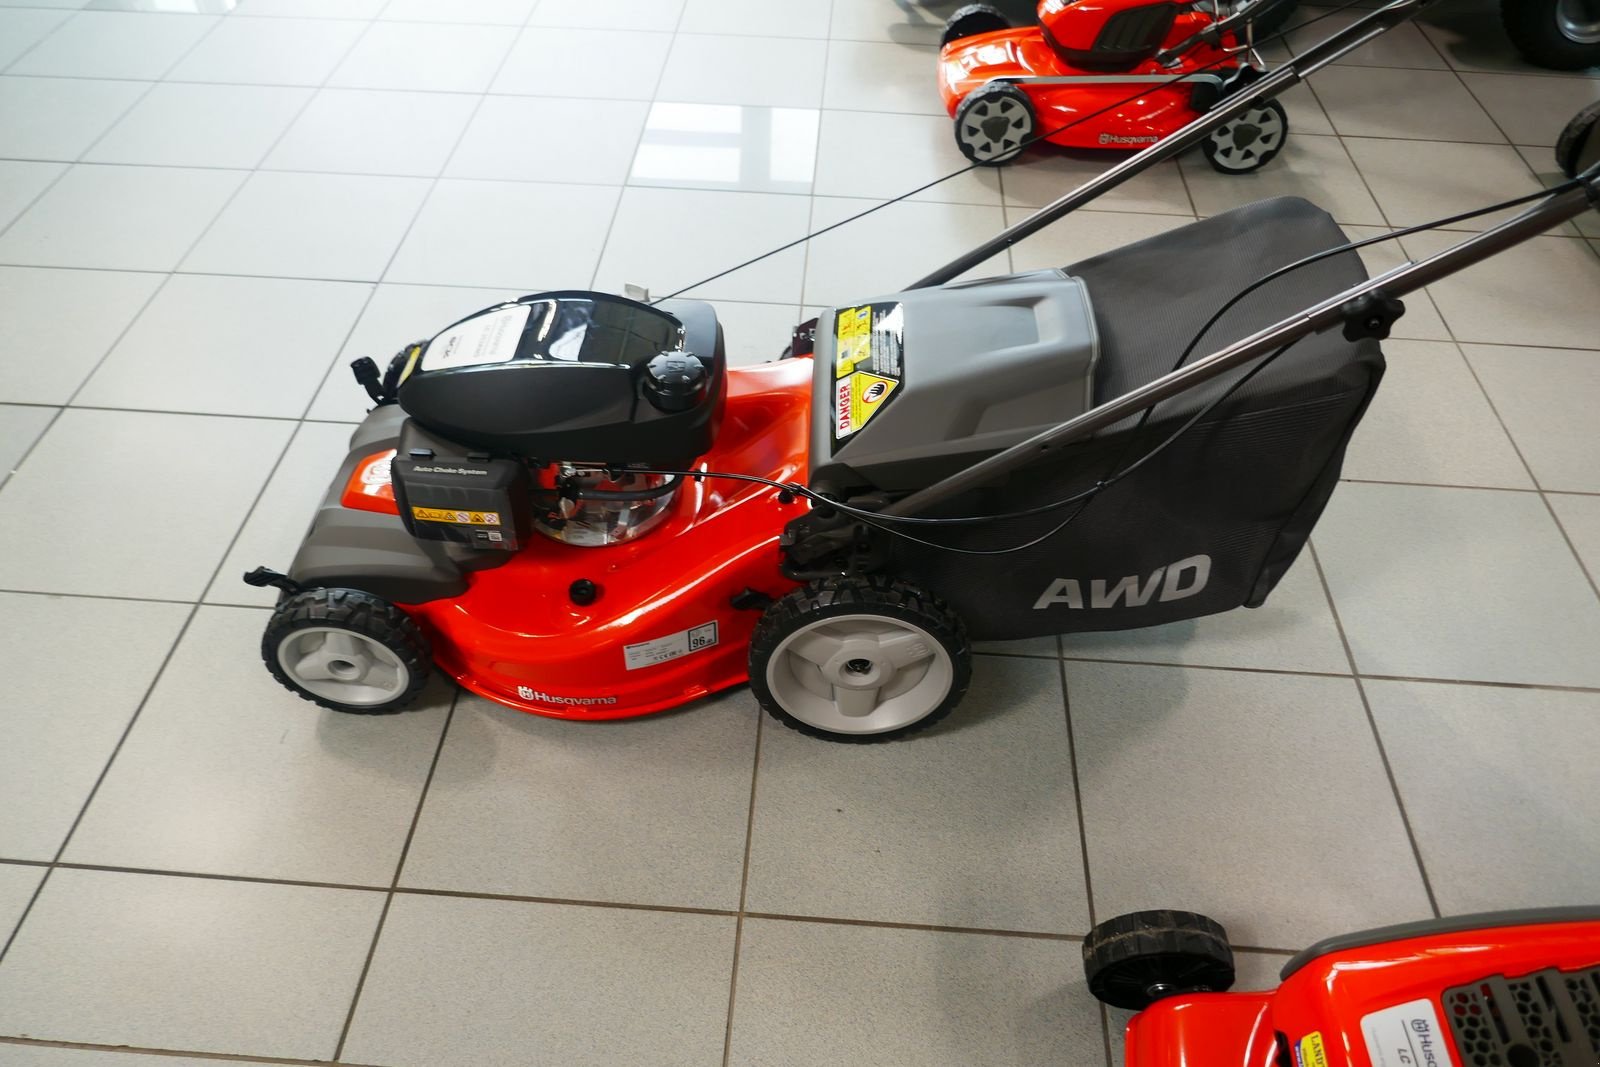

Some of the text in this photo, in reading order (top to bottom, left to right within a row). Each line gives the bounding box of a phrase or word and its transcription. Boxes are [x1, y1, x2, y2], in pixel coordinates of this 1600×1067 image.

[839, 383, 851, 430] DANGER
[457, 468, 488, 476] System
[1032, 554, 1212, 610] AWD
[692, 636, 706, 648] 96
[534, 691, 617, 706] Husqvarna
[1311, 1034, 1326, 1067] LAND
[1398, 1048, 1411, 1065] LC
